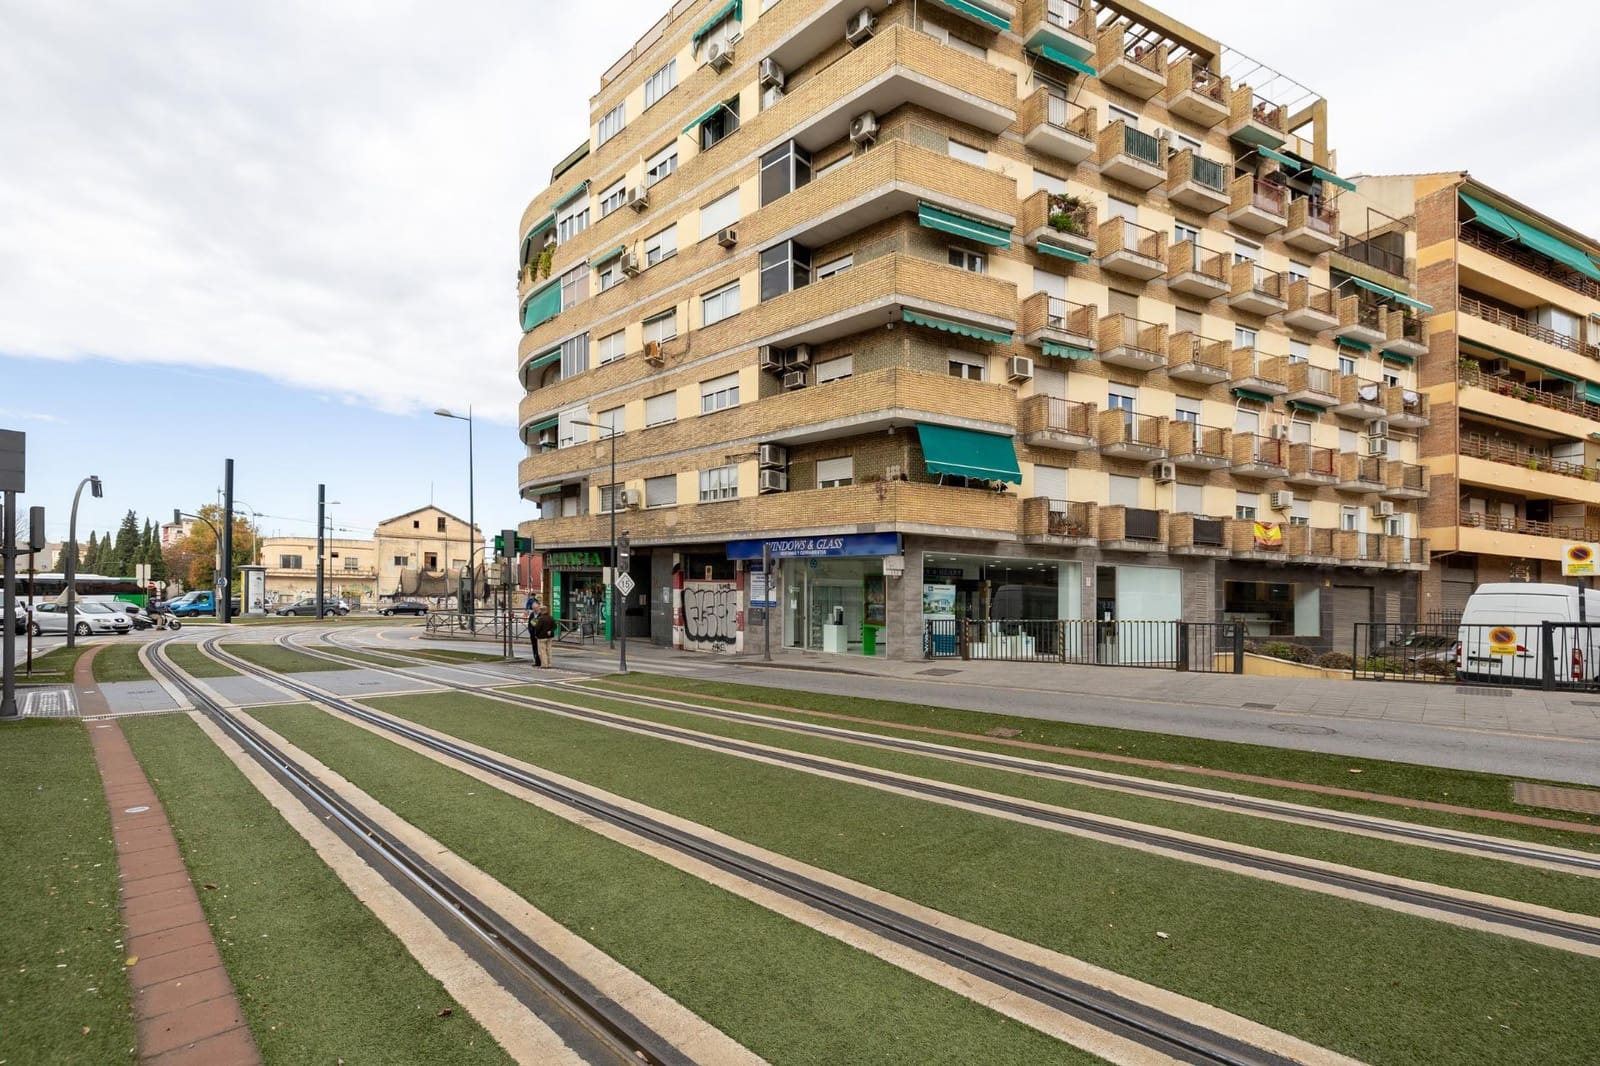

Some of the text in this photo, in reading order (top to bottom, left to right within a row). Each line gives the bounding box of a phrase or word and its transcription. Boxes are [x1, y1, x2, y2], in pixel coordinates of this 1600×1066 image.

[807, 540, 814, 550] &
[816, 537, 844, 550] GLASS
[621, 580, 630, 589] 15
